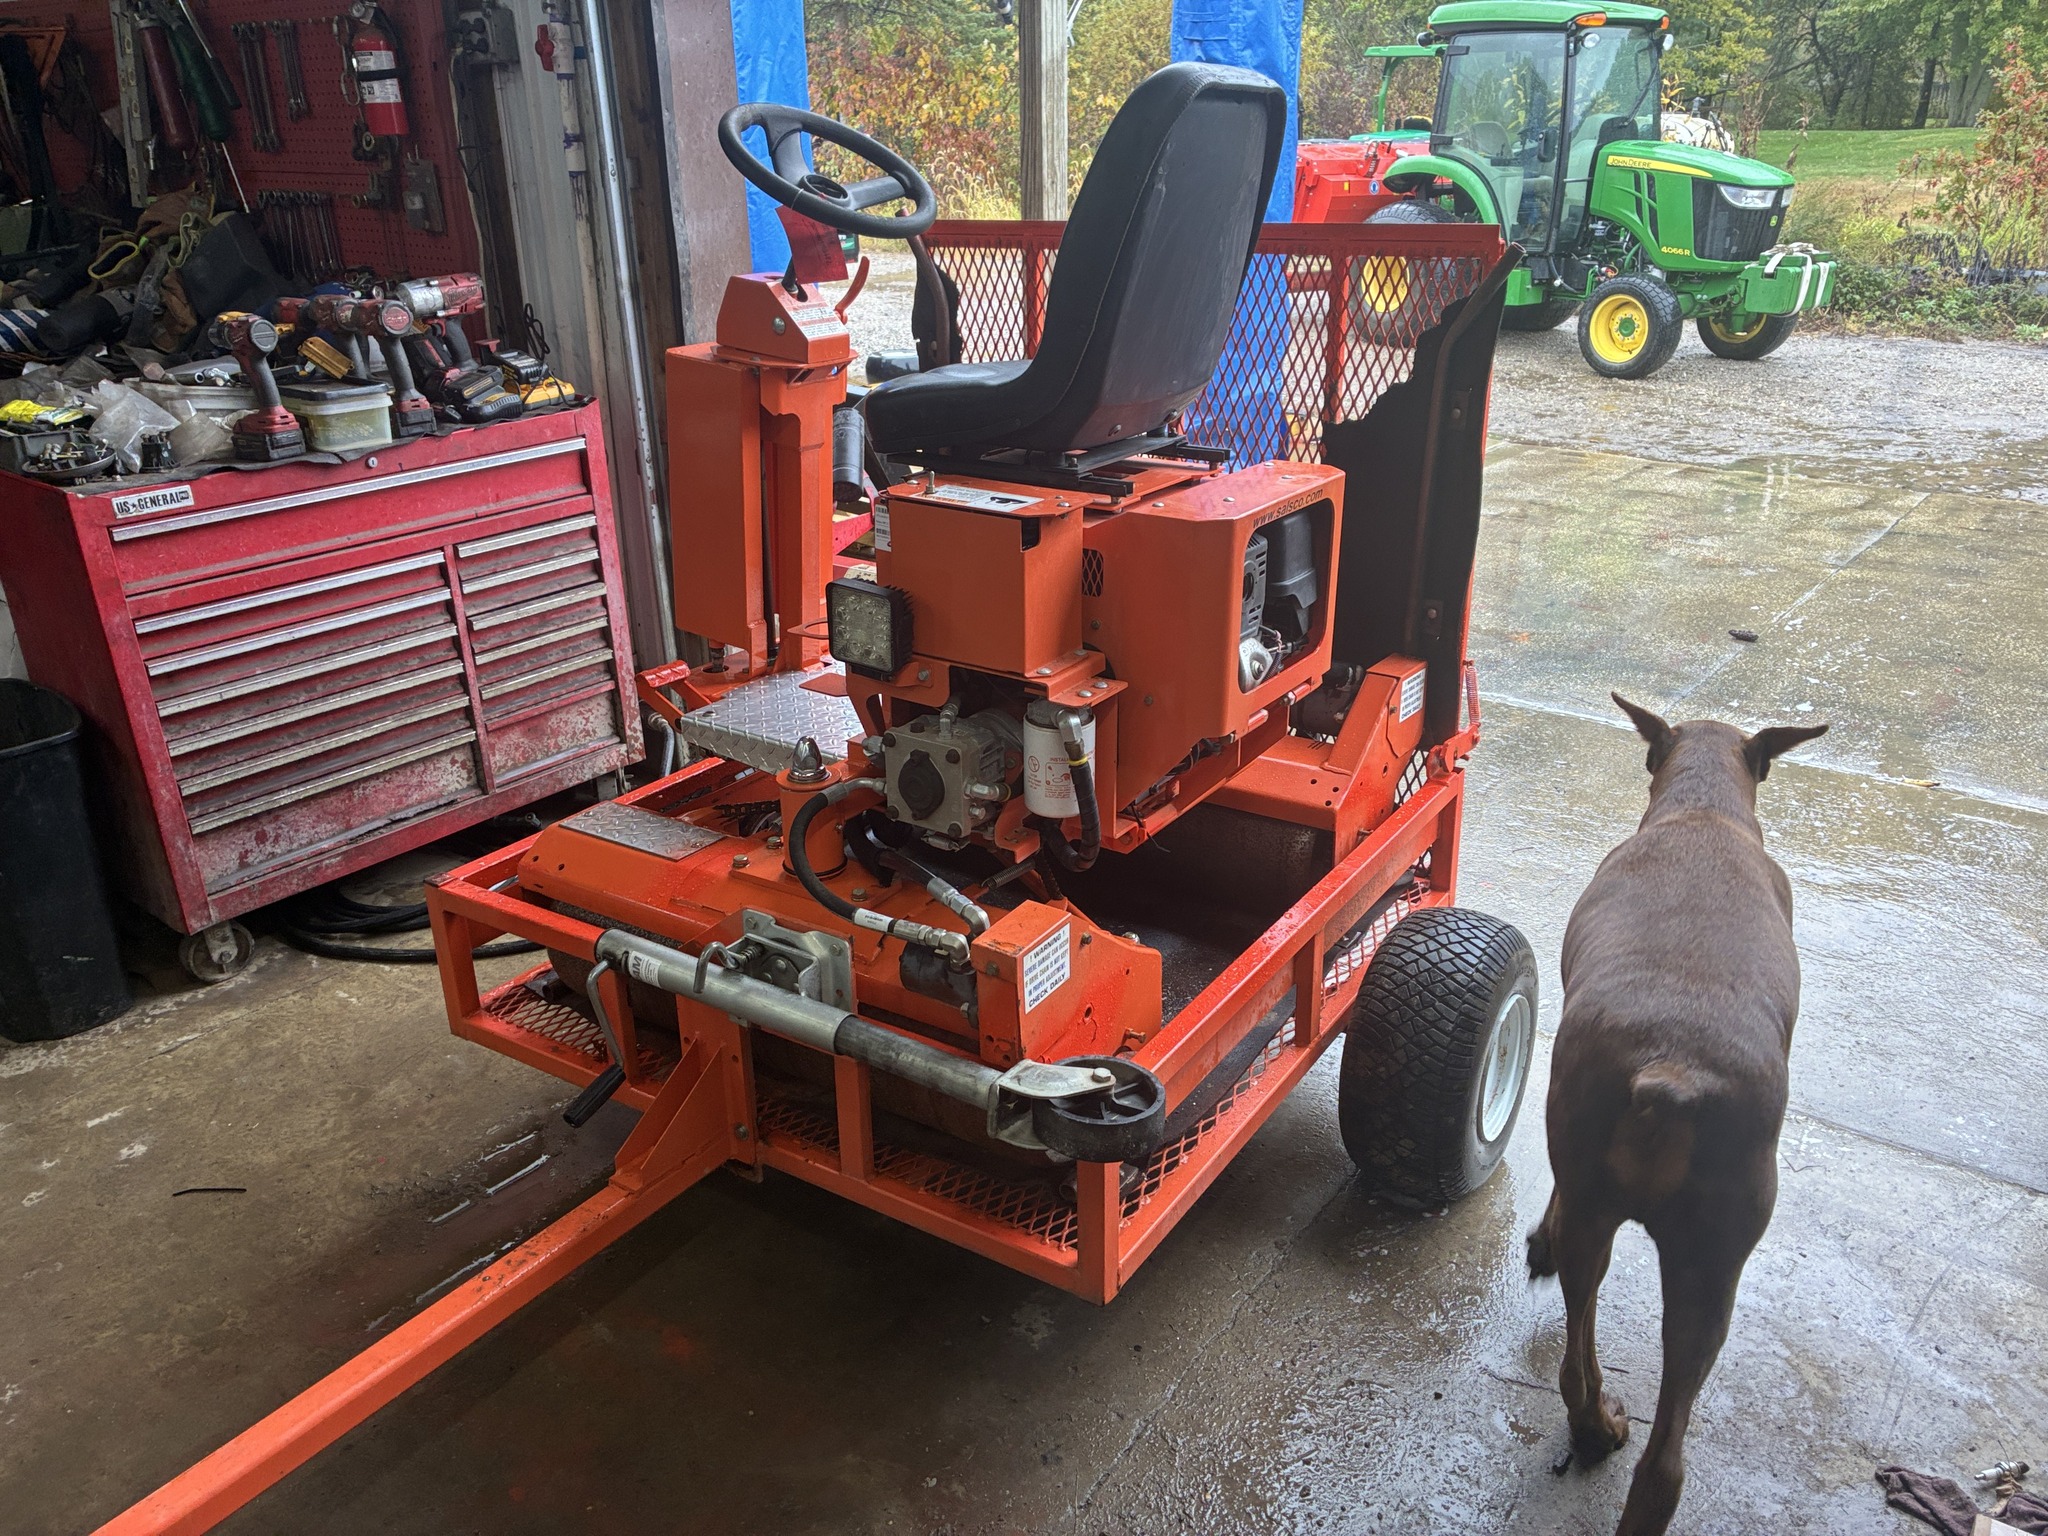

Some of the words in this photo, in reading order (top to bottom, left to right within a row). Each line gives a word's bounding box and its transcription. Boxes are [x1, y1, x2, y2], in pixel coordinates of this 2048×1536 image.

[1610, 157, 1628, 165] JOHN
[1628, 159, 1652, 167] DEERE
[1661, 246, 1691, 256] 4066R
[116, 500, 131, 513] US
[137, 491, 181, 510] GENERAL
[1253, 488, 1323, 528] www.salsco.com
[1033, 933, 1062, 959] WARNING
[1025, 962, 1037, 977] SEVERE
[1038, 951, 1051, 967] DAMAGE
[1029, 972, 1039, 985] DRIVE
[1039, 963, 1049, 977] CHAIN
[1029, 987, 1048, 1007] CHECK
[1050, 972, 1066, 990] DAILY
[1033, 978, 1045, 992] PROPER
